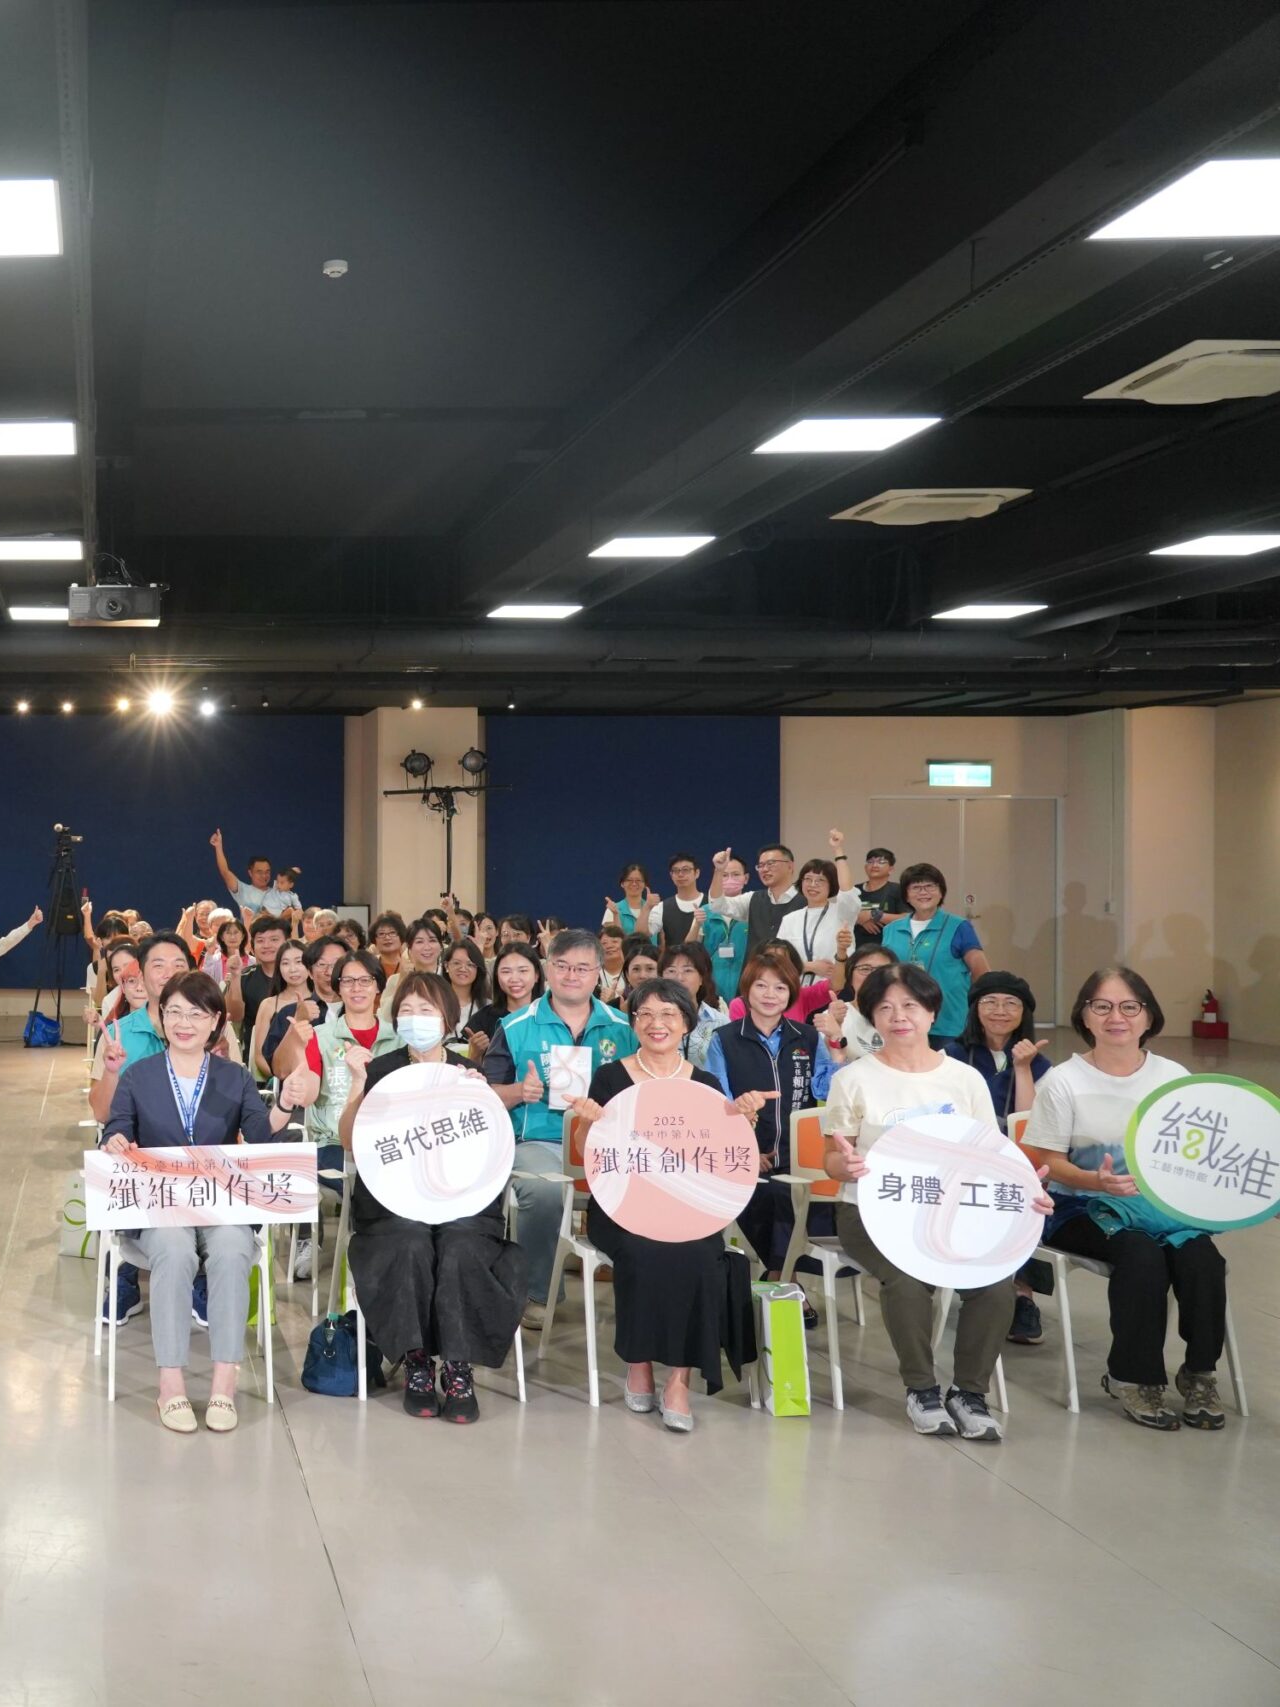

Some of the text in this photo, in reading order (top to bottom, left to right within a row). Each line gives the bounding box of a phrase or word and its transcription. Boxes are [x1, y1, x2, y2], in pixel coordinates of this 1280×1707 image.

[653, 1116, 686, 1127] 2025
[374, 1107, 489, 1166] 當代思維
[112, 1161, 149, 1174] 2025
[592, 1146, 752, 1175] 纖維創作獎
[107, 1172, 294, 1212] 纖維創作獎
